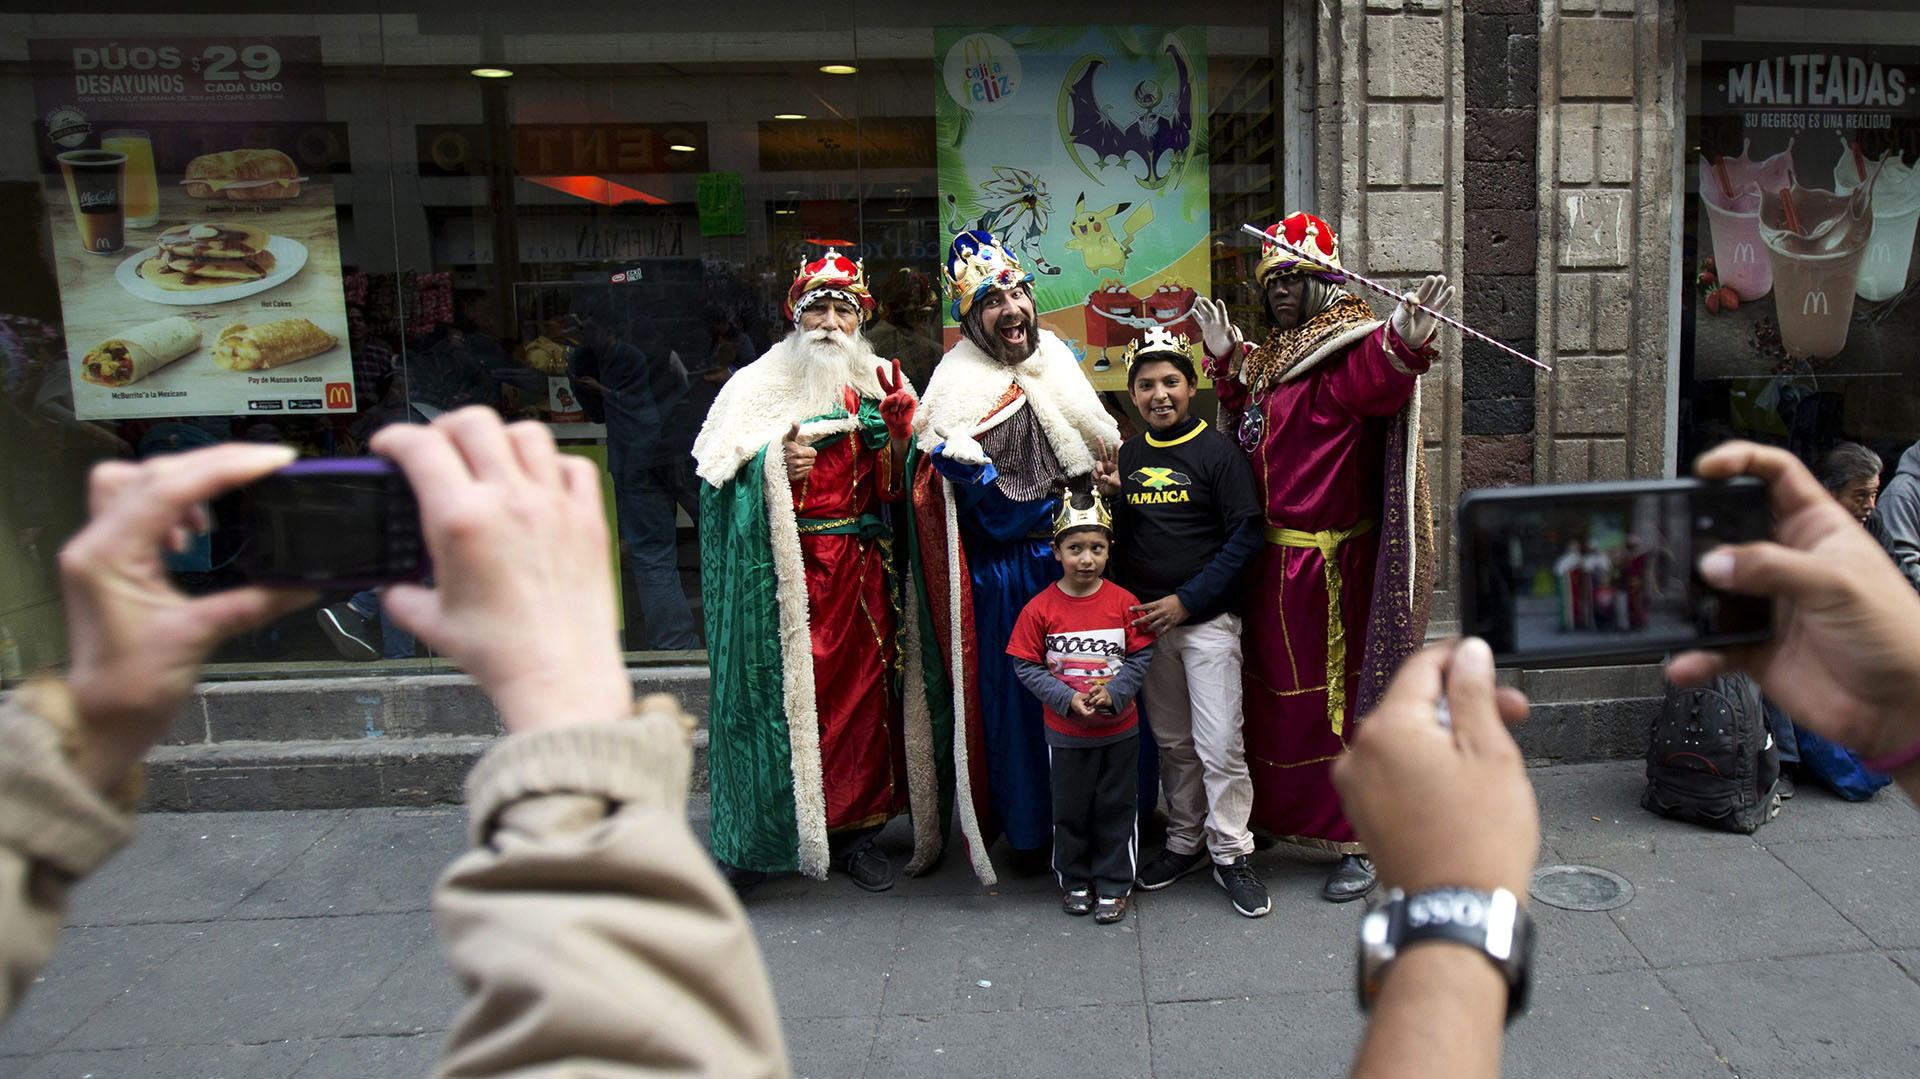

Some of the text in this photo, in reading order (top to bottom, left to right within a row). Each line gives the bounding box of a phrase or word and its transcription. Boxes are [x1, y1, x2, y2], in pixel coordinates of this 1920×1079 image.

[73, 42, 182, 71] DÚOS
[75, 74, 185, 95] DESAYUNOS
[204, 82, 284, 93] CADA UNO
[962, 75, 1011, 104] feliz
[1728, 54, 1907, 106] MALTEADAS
[1744, 112, 1892, 129] SU REGRESO ES UNA REALIDAD
[248, 376, 260, 384] Pay
[157, 390, 187, 398] Mexicana
